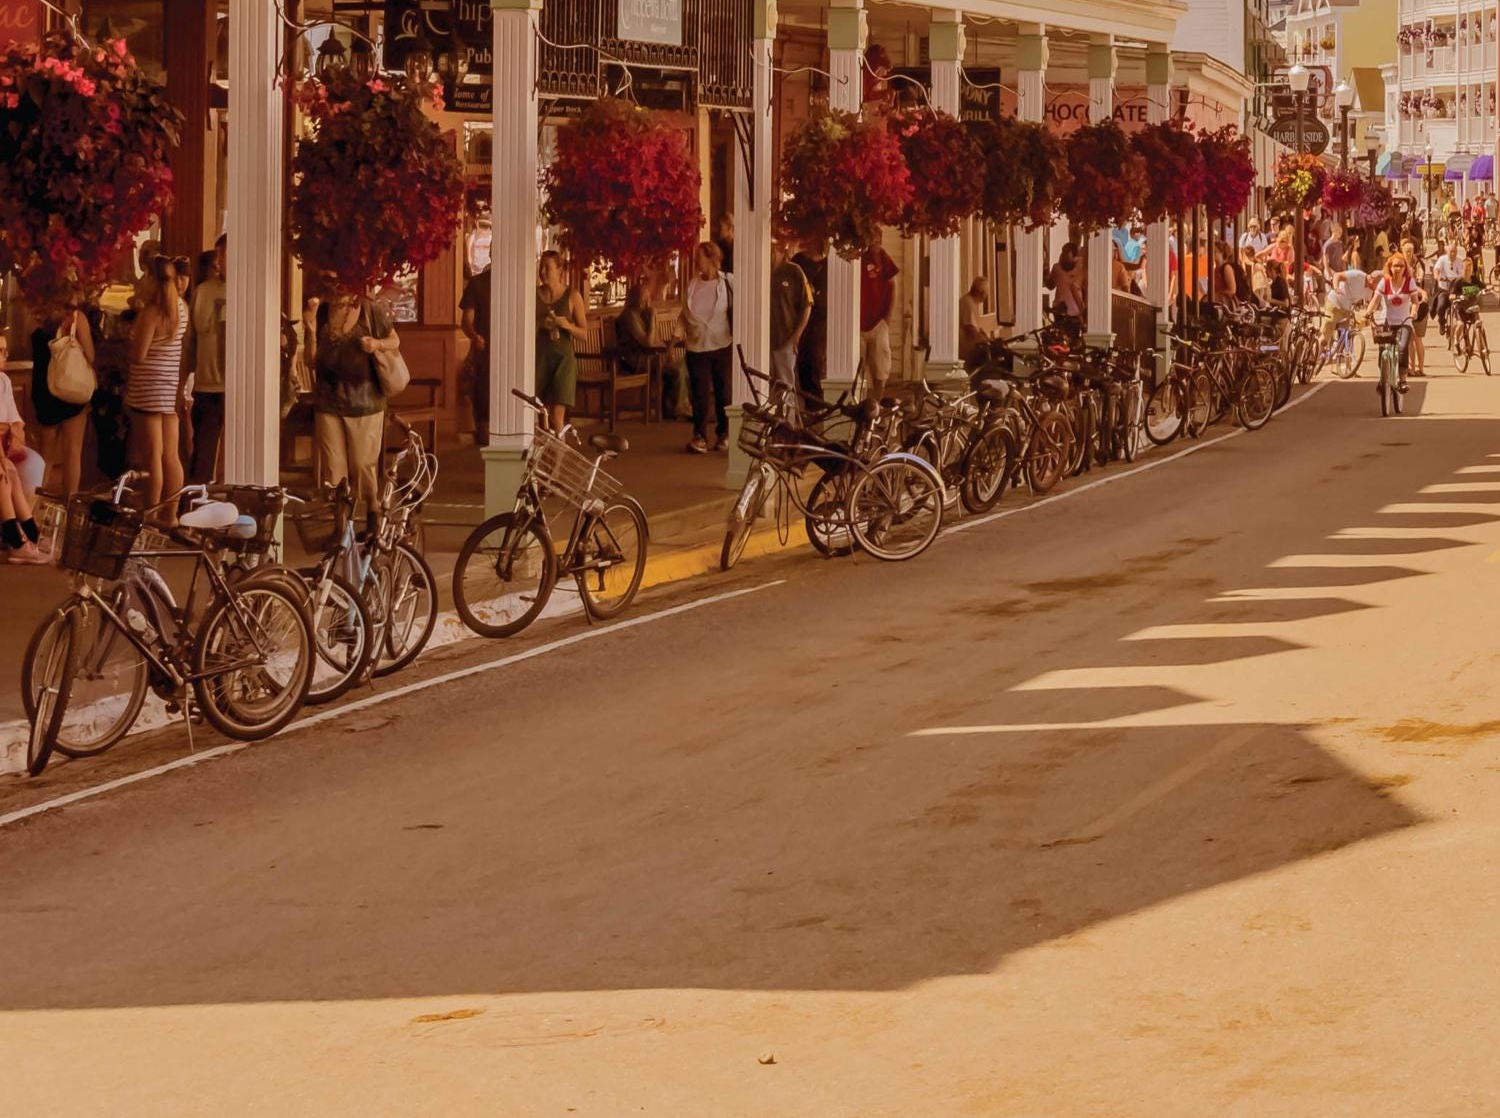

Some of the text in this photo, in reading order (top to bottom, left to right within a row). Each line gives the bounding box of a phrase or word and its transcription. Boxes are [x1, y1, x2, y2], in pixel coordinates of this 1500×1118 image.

[467, 47, 492, 64] Pub
[1045, 103, 1148, 122] HOCATE
[1273, 130, 1324, 144] HARBSIDE
